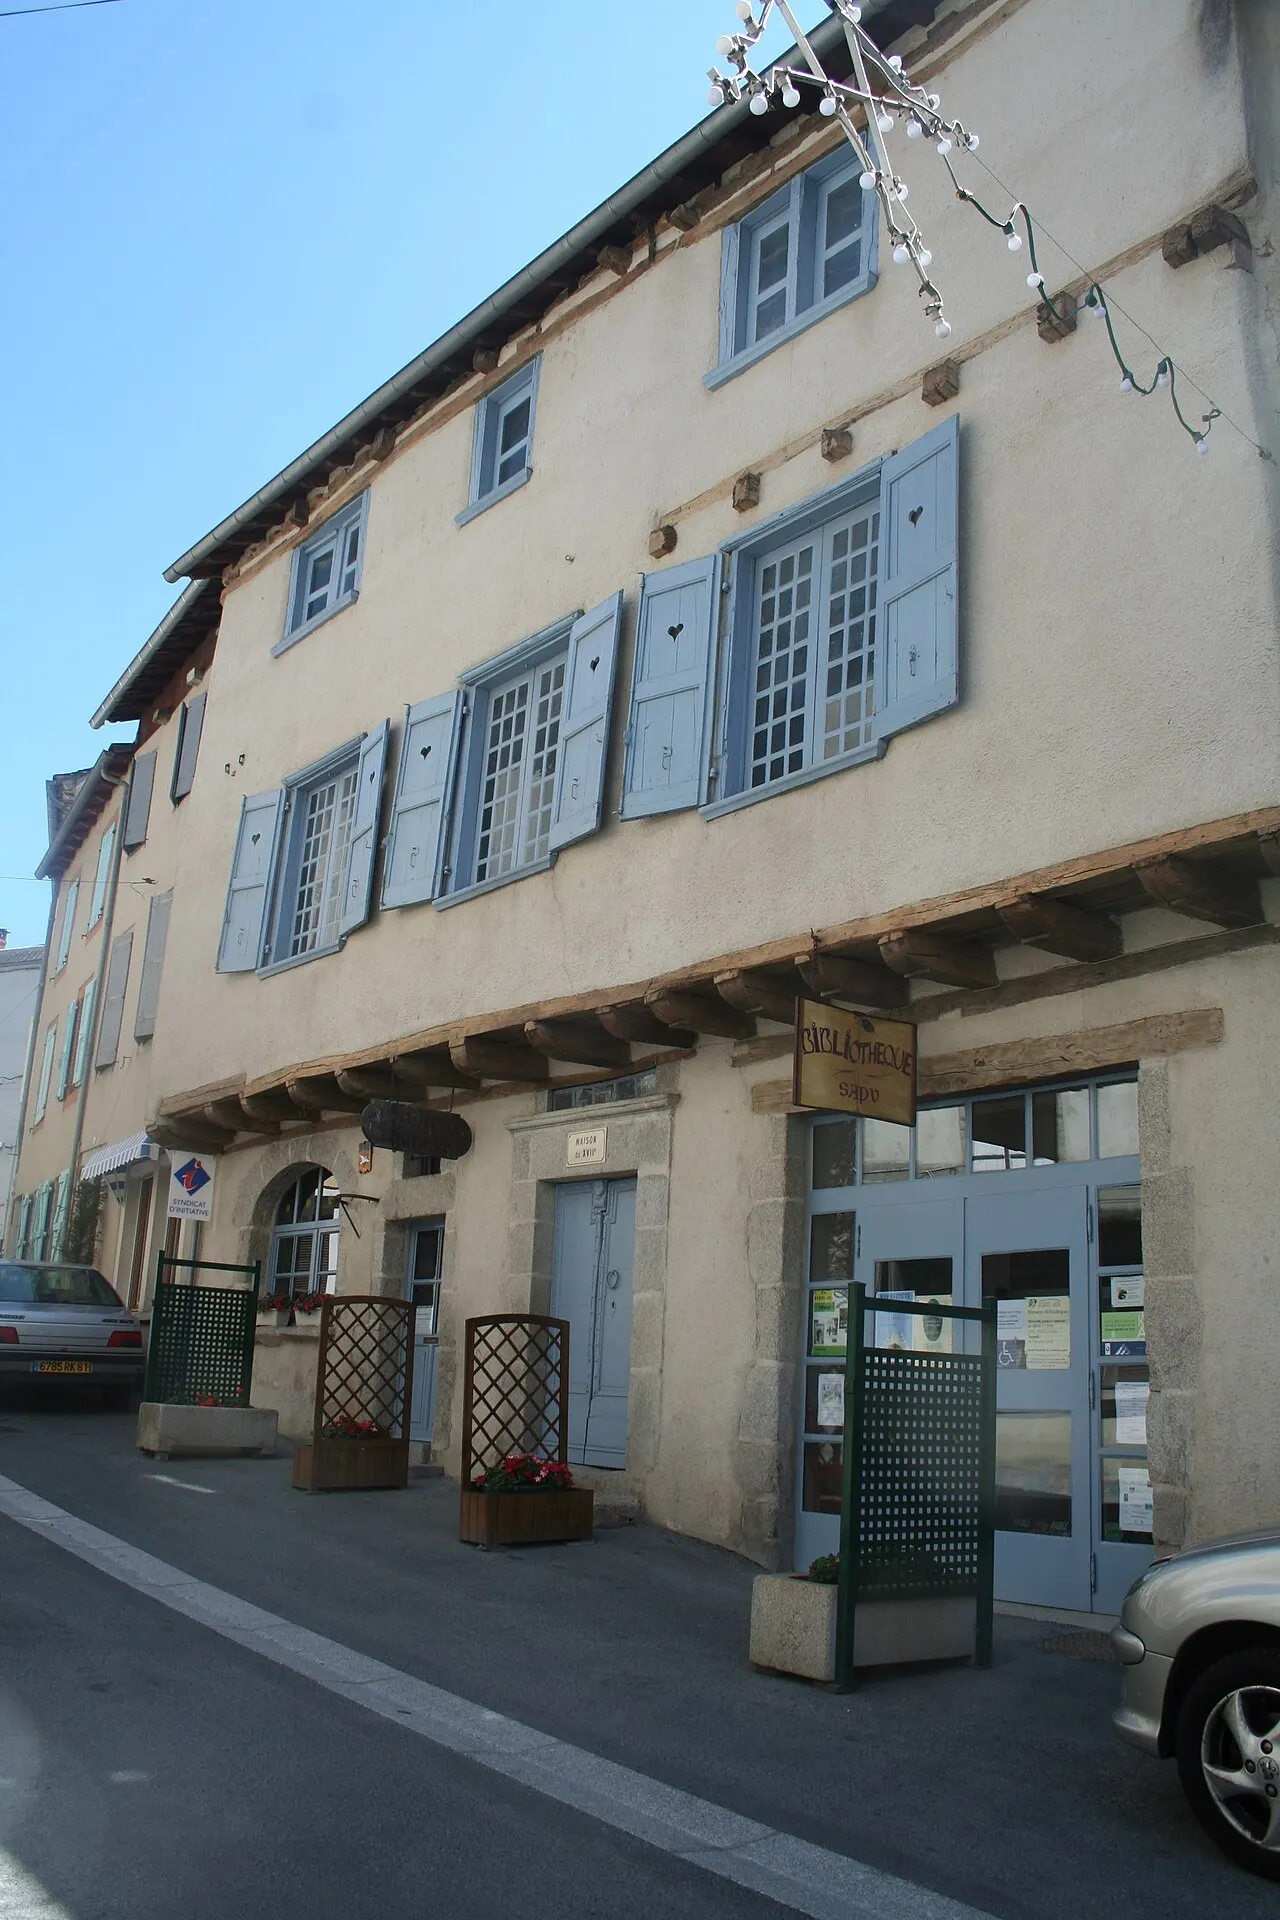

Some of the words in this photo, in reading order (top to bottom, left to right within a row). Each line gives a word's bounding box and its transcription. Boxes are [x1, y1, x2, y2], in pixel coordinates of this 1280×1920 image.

[172, 1199, 207, 1208] SYNDICAT
[169, 1206, 209, 1217] D'INITIATIVE
[39, 1361, 64, 1372] 6785
[77, 1362, 88, 1372] 81
